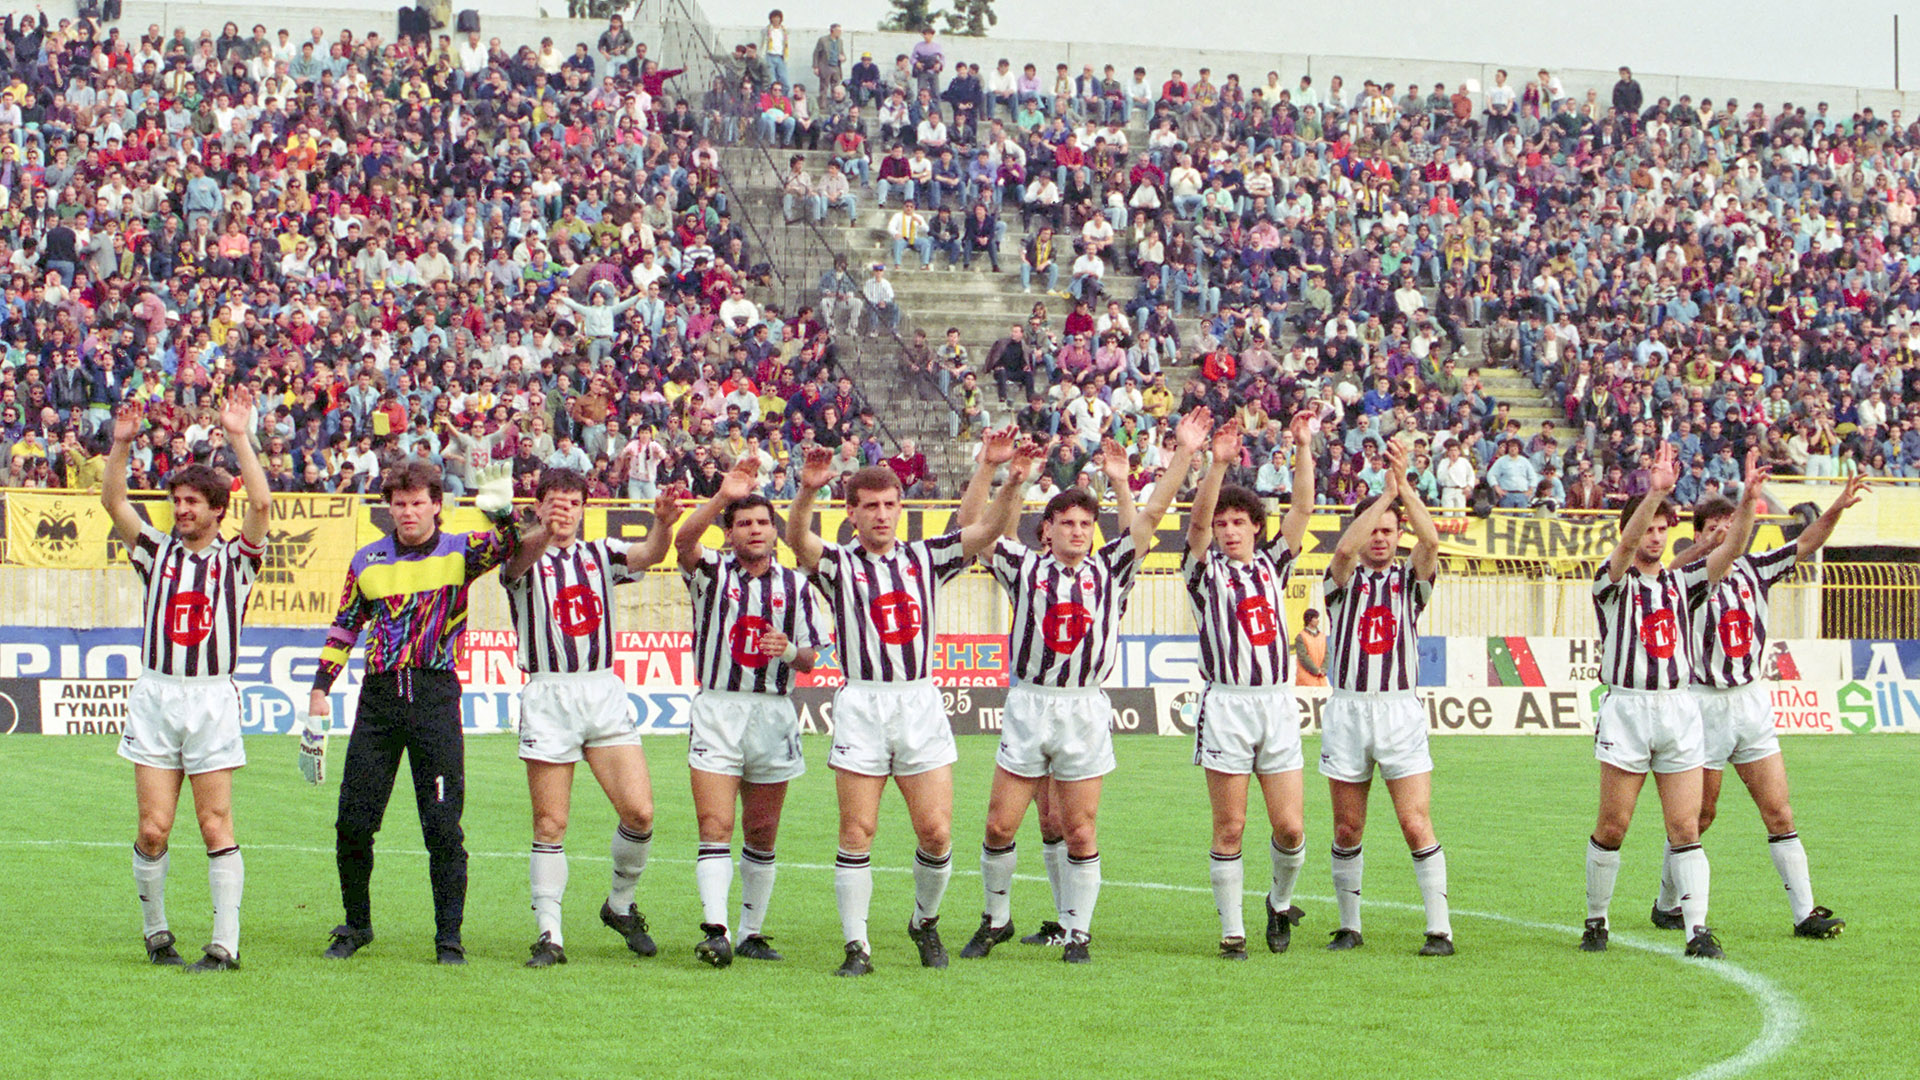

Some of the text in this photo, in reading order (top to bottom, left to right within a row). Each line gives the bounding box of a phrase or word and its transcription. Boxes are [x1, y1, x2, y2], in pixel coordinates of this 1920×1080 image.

[252, 589, 333, 613] AHAMI
[1770, 685, 1818, 707] ιπλα
[1421, 691, 1493, 729] ice
[1515, 691, 1581, 729] AE
[435, 775, 446, 802] 1
